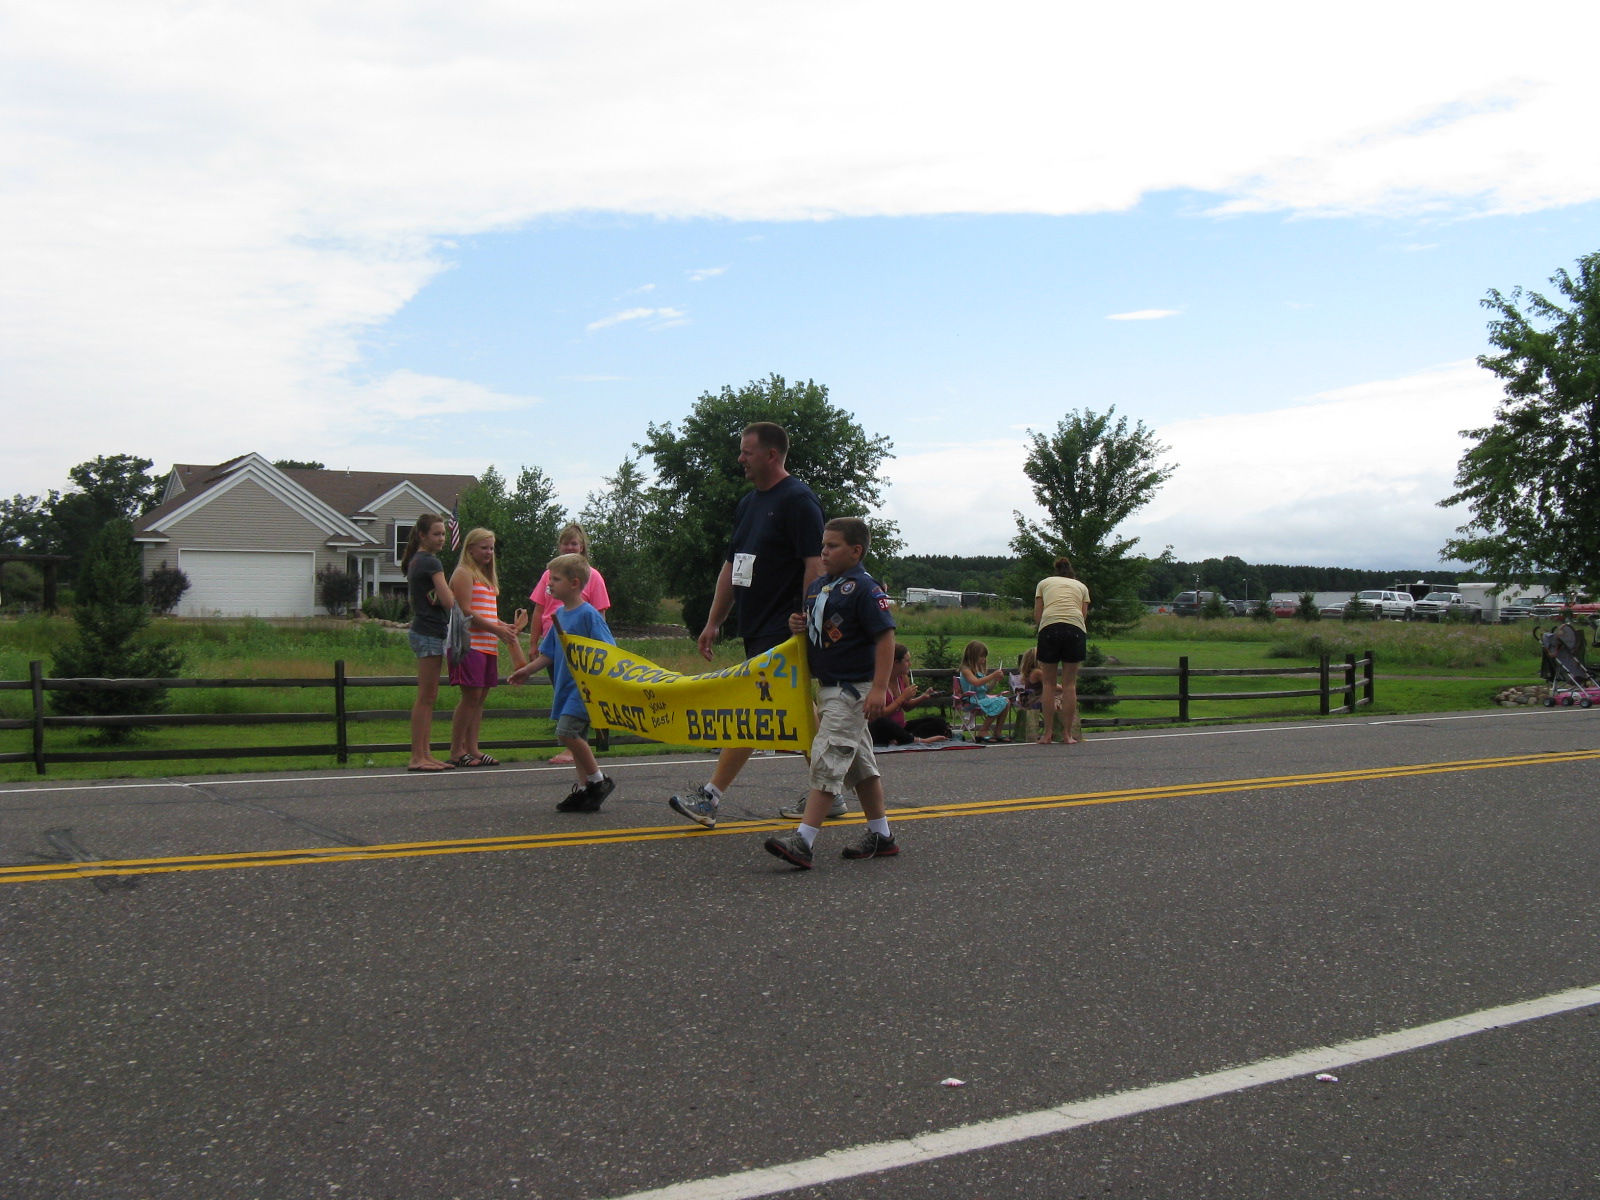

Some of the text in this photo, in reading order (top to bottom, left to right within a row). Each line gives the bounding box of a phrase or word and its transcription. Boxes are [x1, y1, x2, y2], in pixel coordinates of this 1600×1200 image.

[566, 642, 608, 676] CUB
[598, 700, 798, 741] EAST BETHEL
